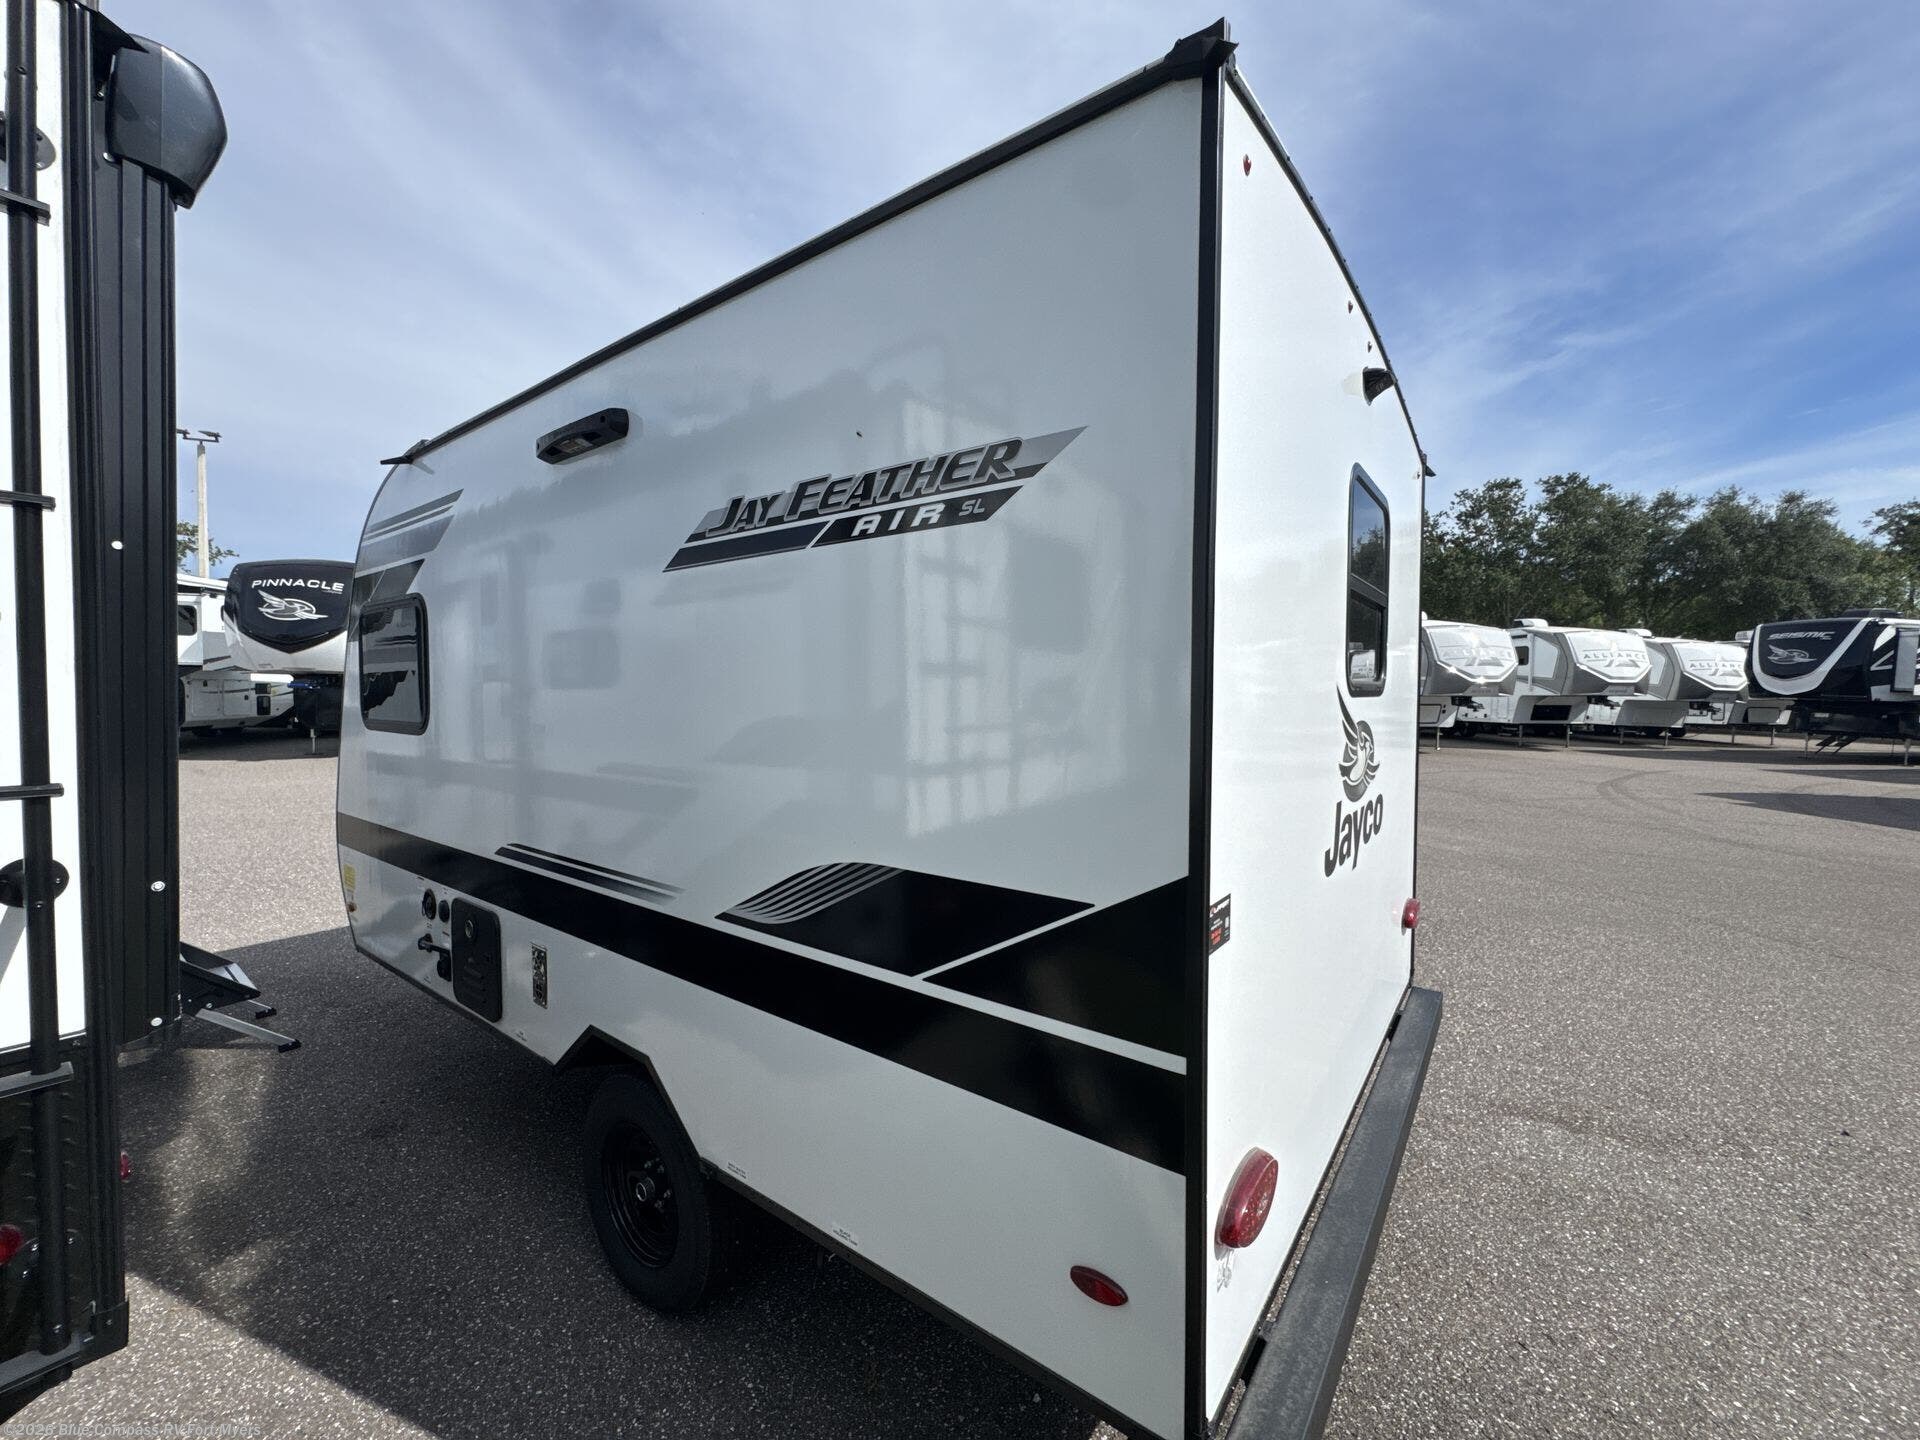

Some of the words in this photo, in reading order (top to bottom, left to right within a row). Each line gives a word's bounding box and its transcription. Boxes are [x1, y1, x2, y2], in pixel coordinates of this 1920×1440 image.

[706, 490, 785, 537] JAY
[784, 436, 1023, 520] FEATHER
[851, 501, 946, 538] AIR
[958, 498, 986, 517] SL
[251, 578, 345, 592] PINNACLE
[1324, 793, 1384, 878] Jayco
